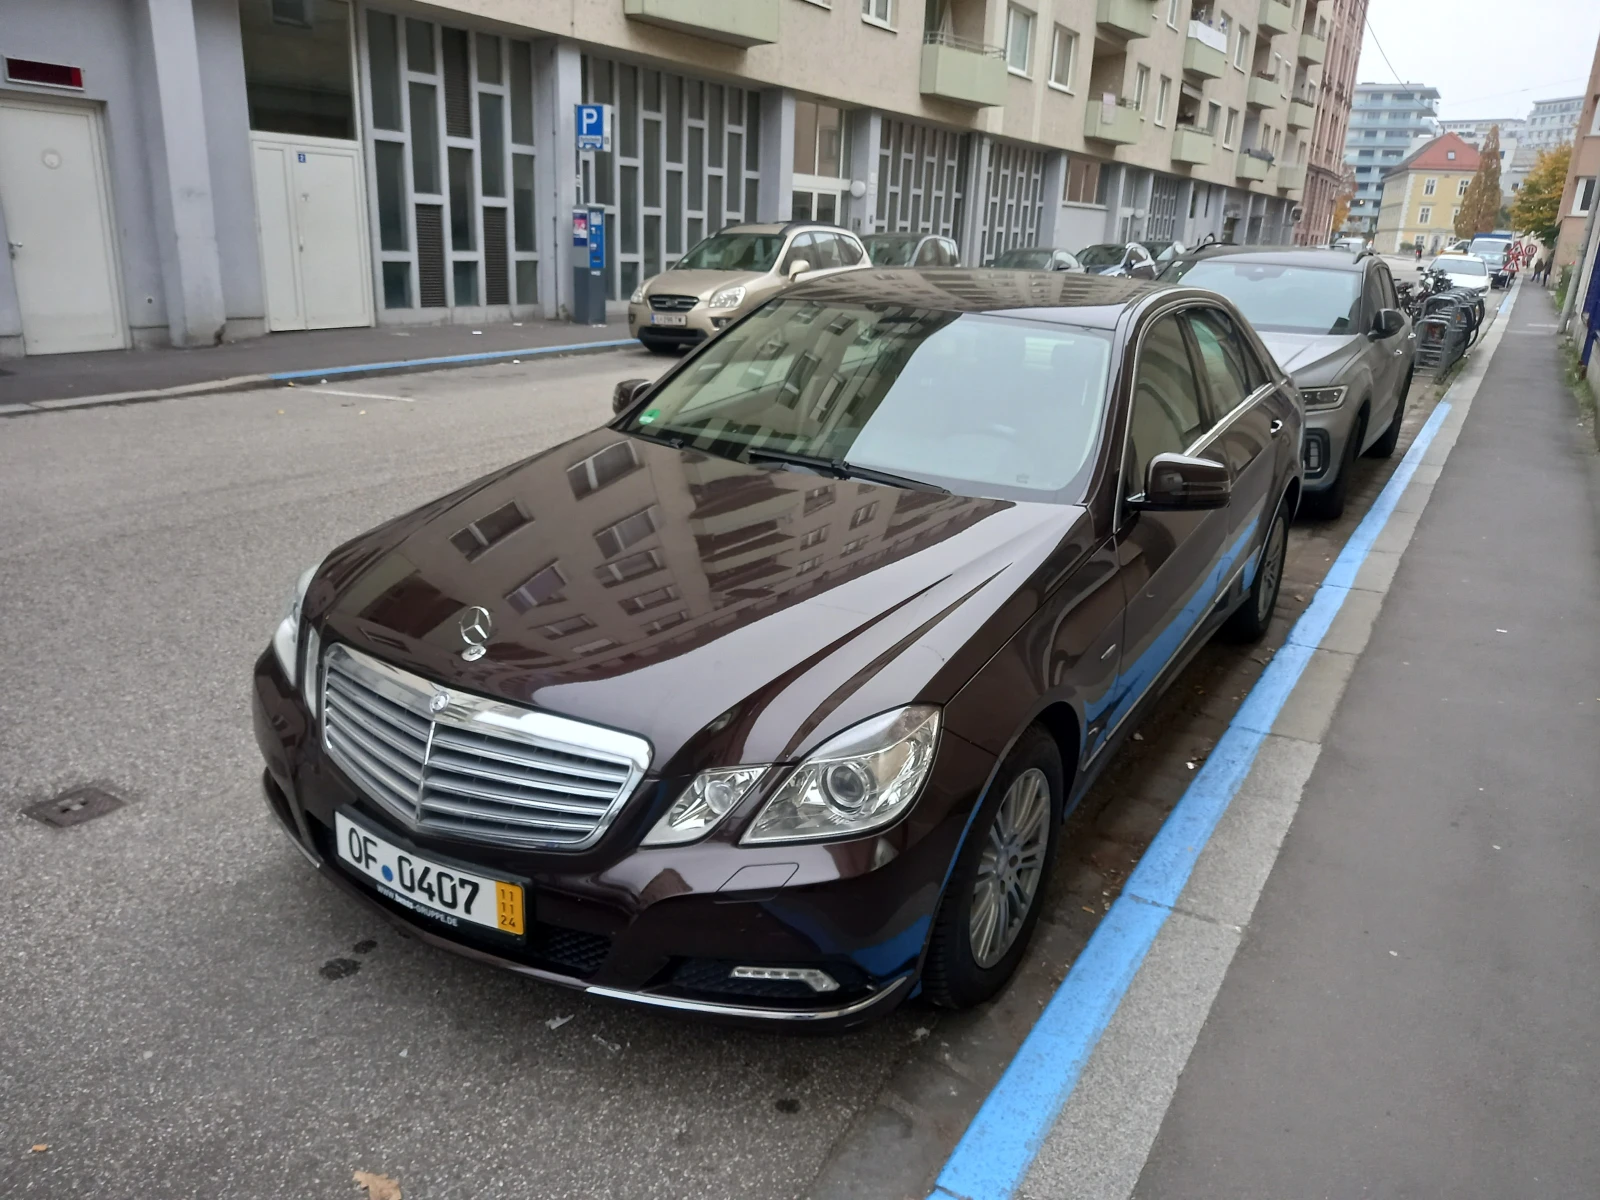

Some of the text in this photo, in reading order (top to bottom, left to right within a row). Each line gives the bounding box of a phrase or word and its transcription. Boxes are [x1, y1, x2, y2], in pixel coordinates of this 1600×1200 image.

[582, 108, 598, 135] P
[348, 827, 480, 915] OF 0407
[501, 888, 514, 902] 11
[501, 901, 514, 915] 11
[501, 914, 516, 928] 24
